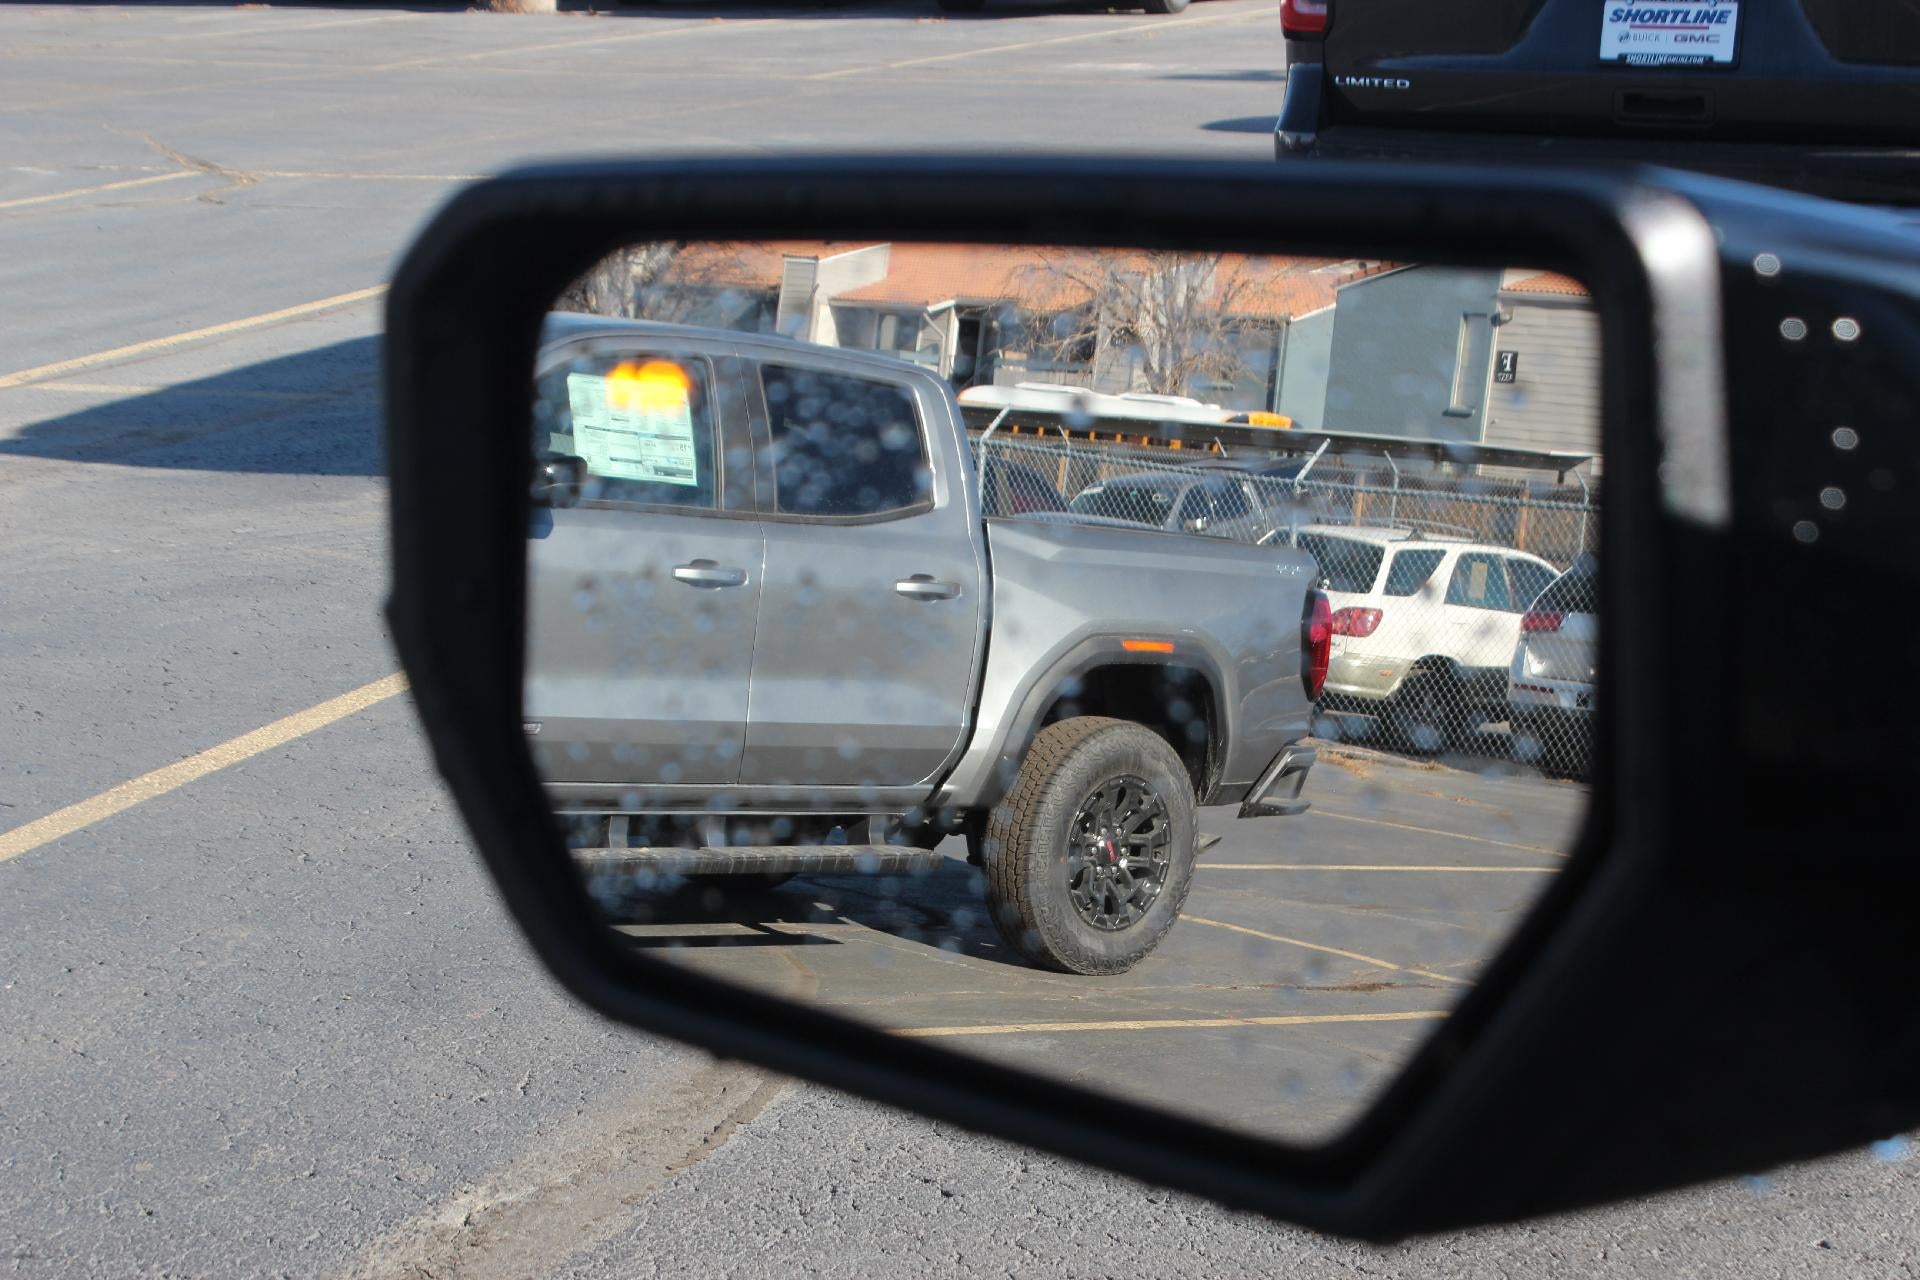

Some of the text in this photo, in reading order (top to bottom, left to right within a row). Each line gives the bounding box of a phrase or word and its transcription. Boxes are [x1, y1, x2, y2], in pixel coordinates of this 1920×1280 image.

[1609, 8, 1732, 24] SHORTLINE
[1632, 33, 1720, 44] BUICK GMC
[1335, 75, 1410, 89] LIMITED
